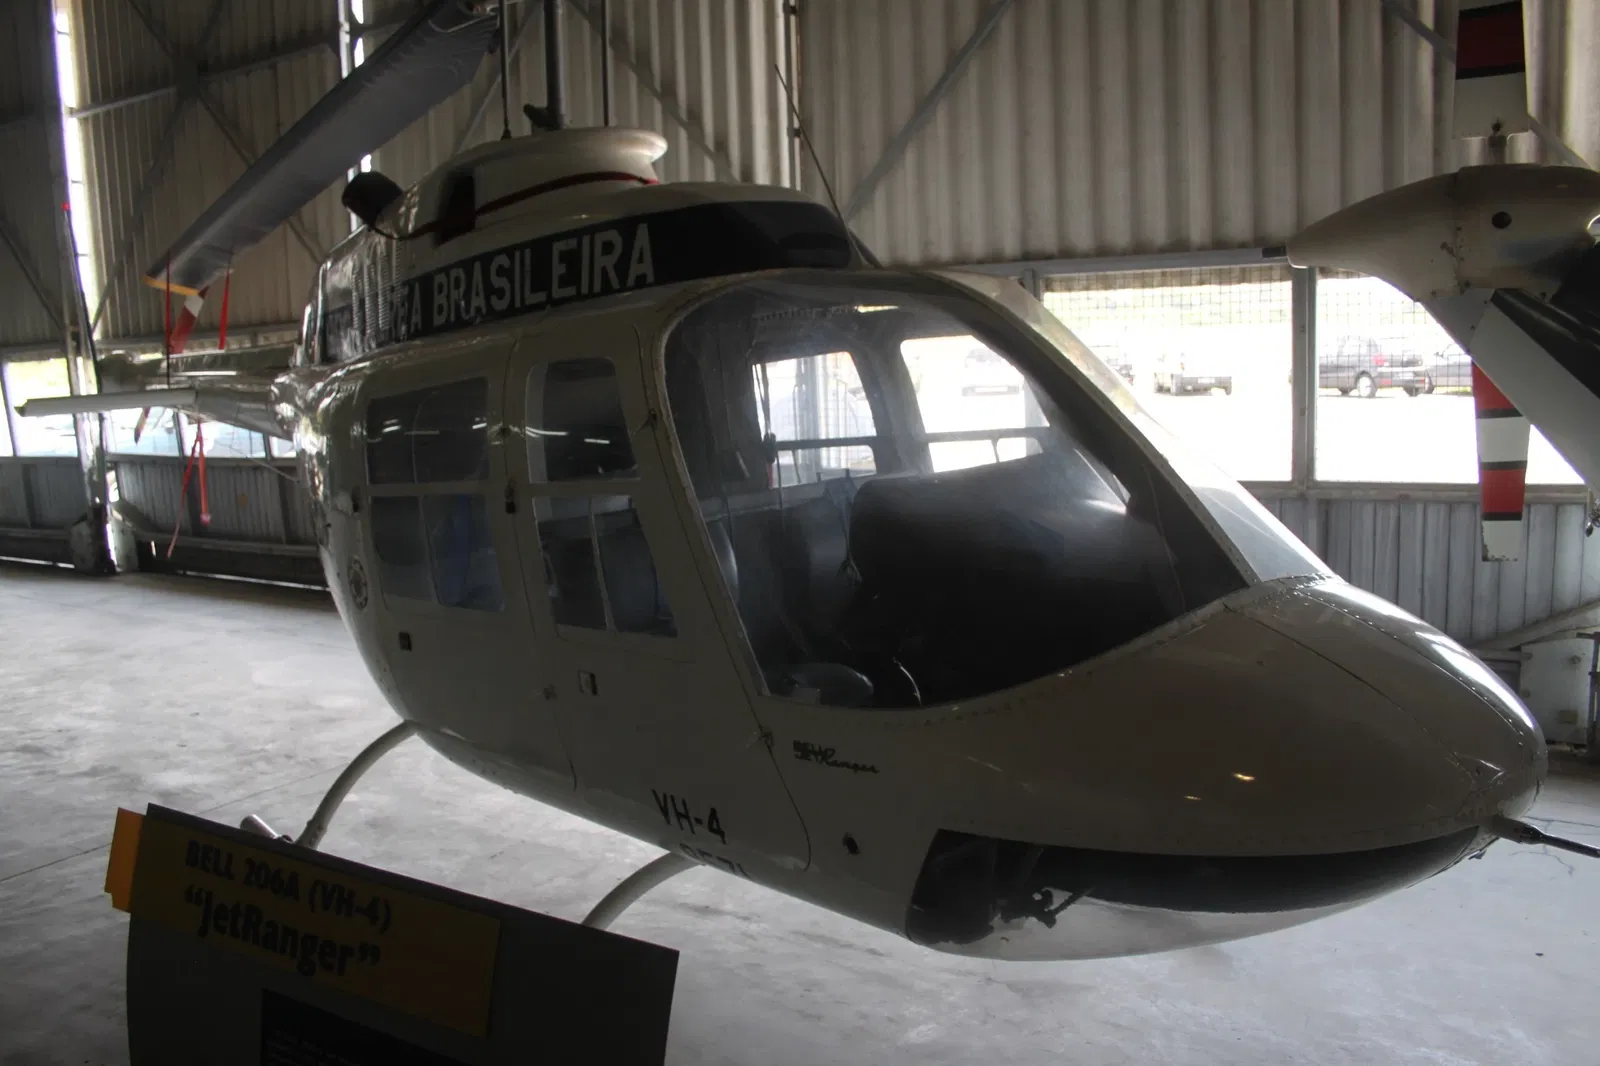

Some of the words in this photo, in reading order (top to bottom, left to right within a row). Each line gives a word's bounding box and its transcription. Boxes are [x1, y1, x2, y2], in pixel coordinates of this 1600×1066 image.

[432, 223, 655, 328] BRASILEIRA
[652, 788, 728, 846] VH-4
[185, 839, 236, 881] BELL
[243, 857, 301, 902] 206A
[308, 879, 393, 935] (VH-4)
